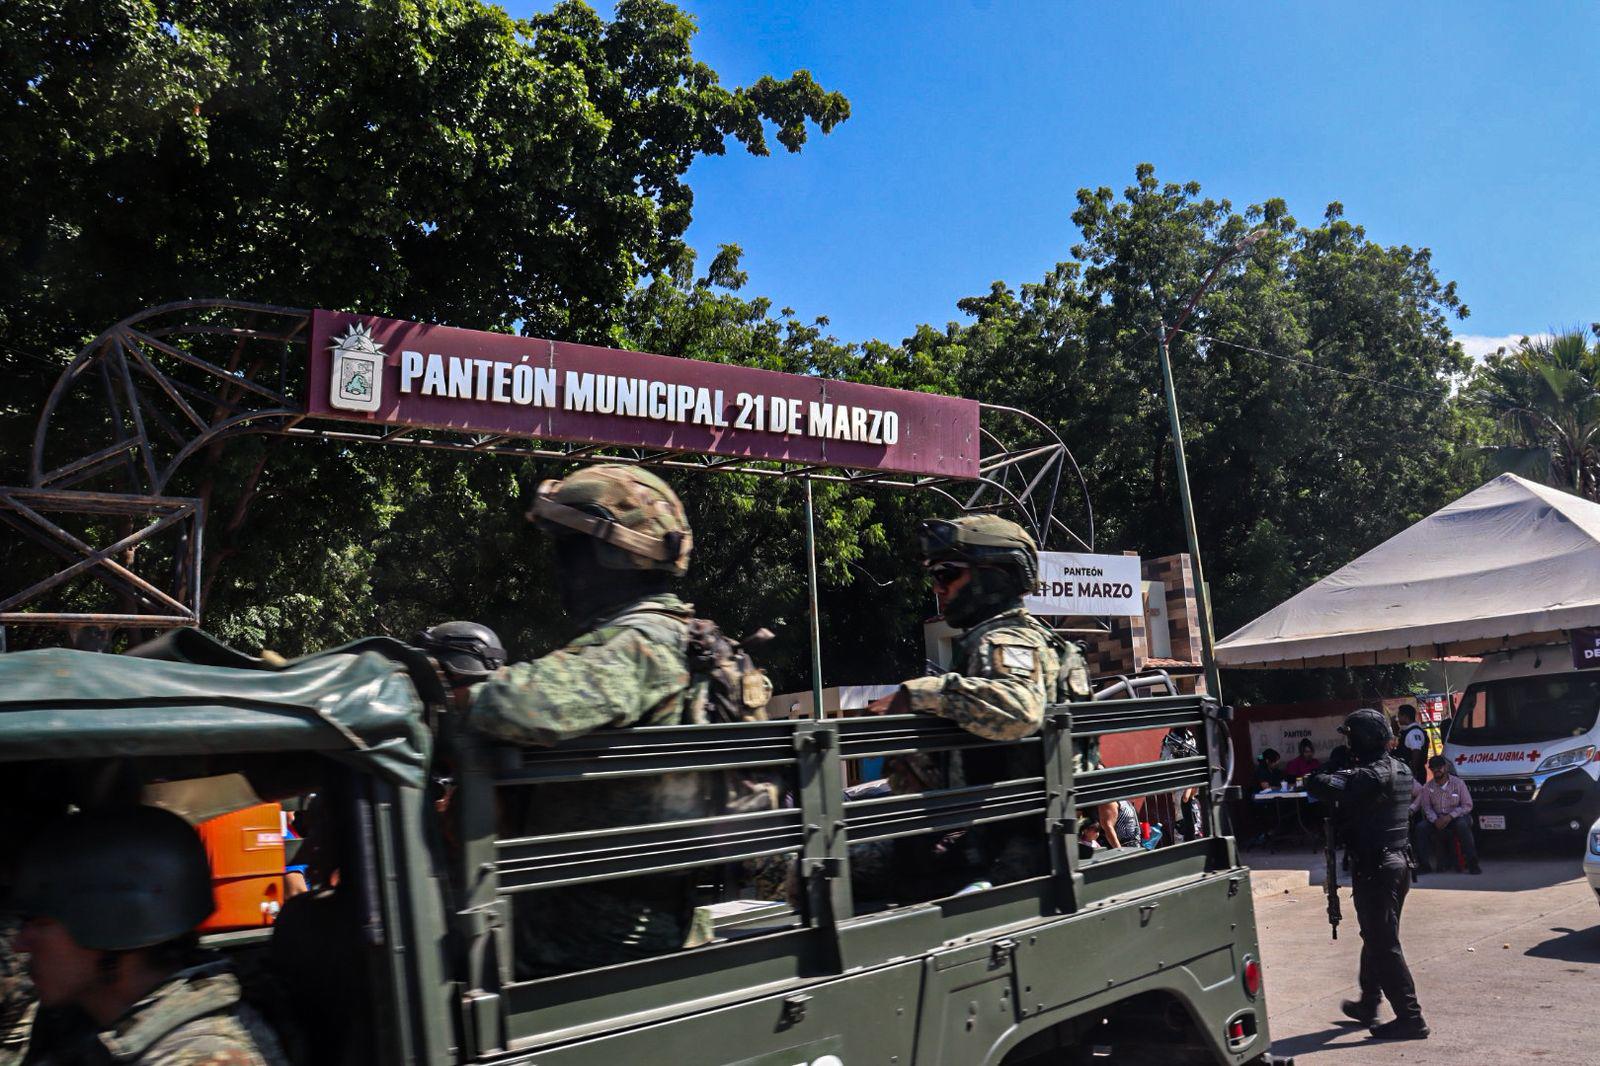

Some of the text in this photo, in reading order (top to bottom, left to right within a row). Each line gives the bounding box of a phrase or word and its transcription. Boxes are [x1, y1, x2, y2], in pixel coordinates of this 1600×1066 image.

[400, 350, 898, 445] PANTEÓN MUNICIPAL 21 DE MARZO
[1064, 567, 1103, 577] PANTEÓN
[1052, 582, 1073, 597] DE
[1078, 582, 1133, 598] MARZO
